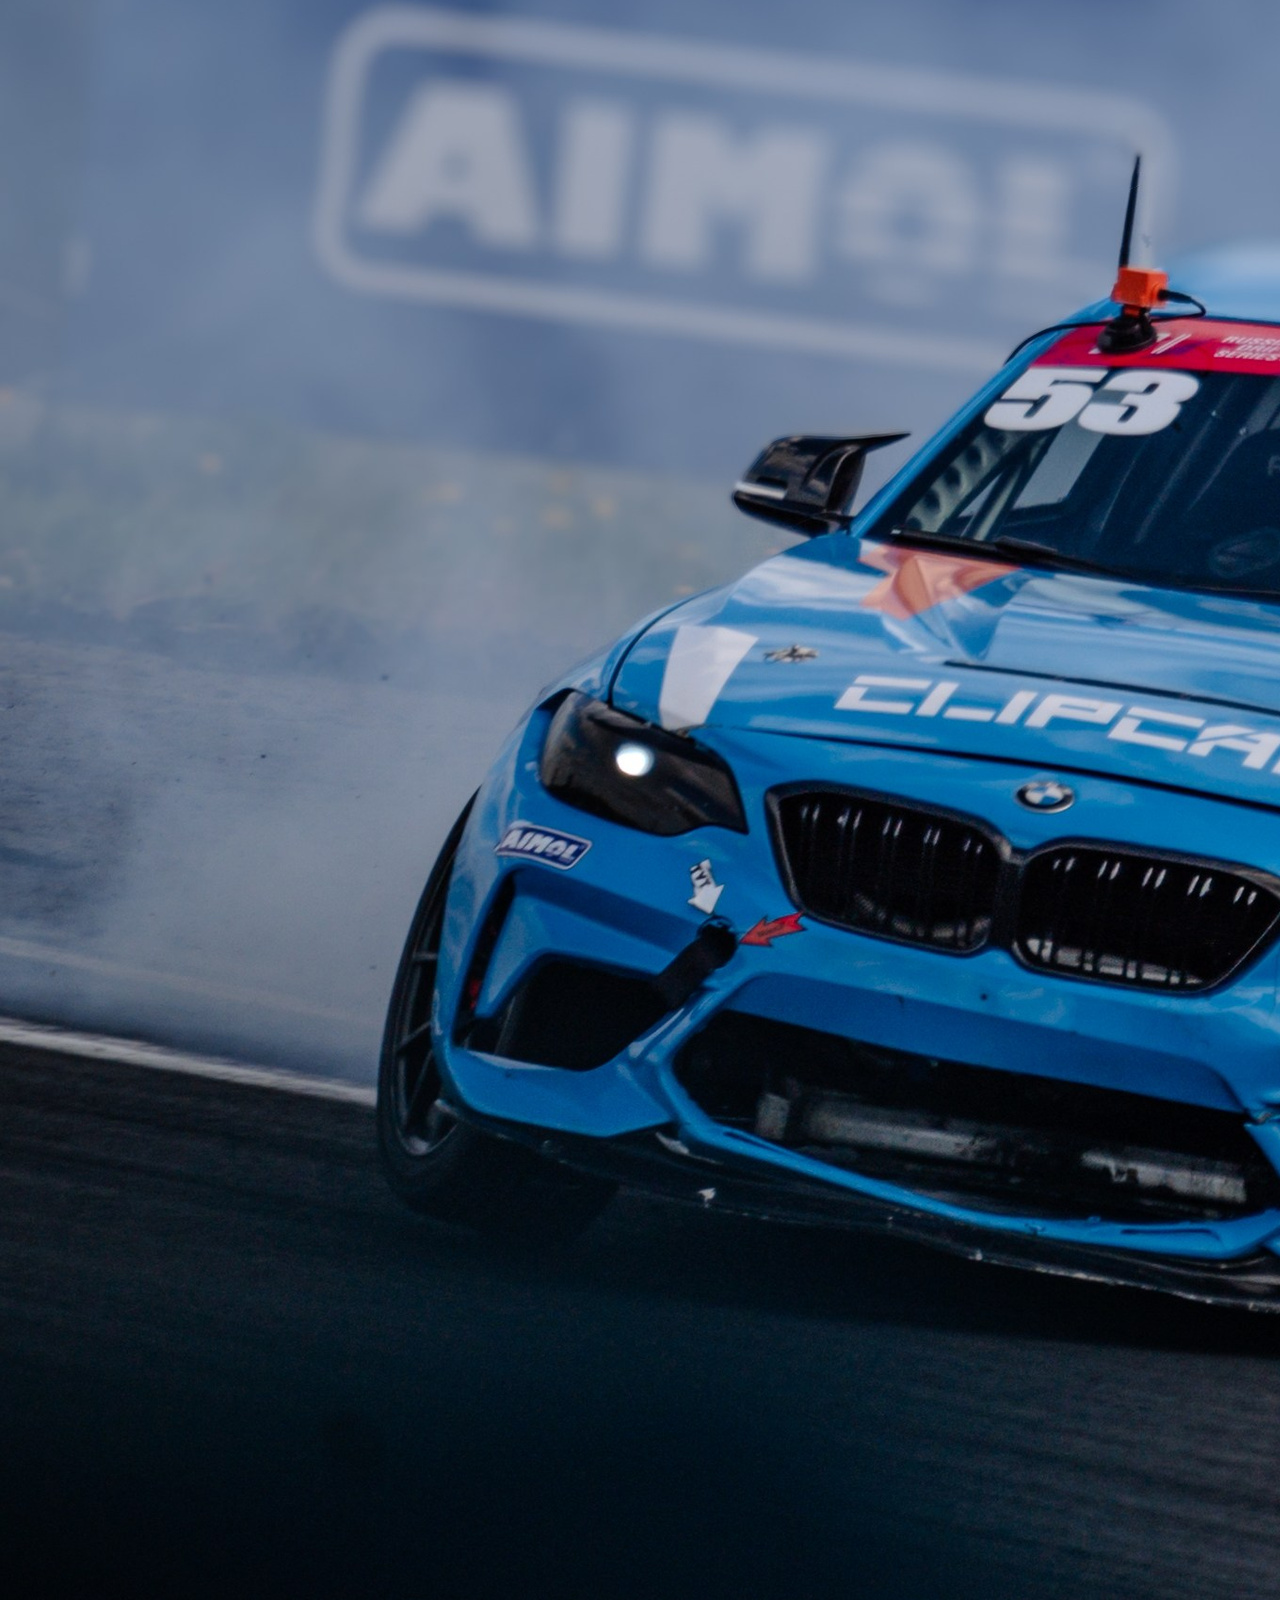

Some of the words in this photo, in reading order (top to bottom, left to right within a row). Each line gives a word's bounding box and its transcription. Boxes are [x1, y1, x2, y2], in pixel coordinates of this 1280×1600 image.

[355, 76, 1102, 295] AIMOL
[984, 367, 1200, 436] 53
[499, 828, 578, 861] AIMOL
